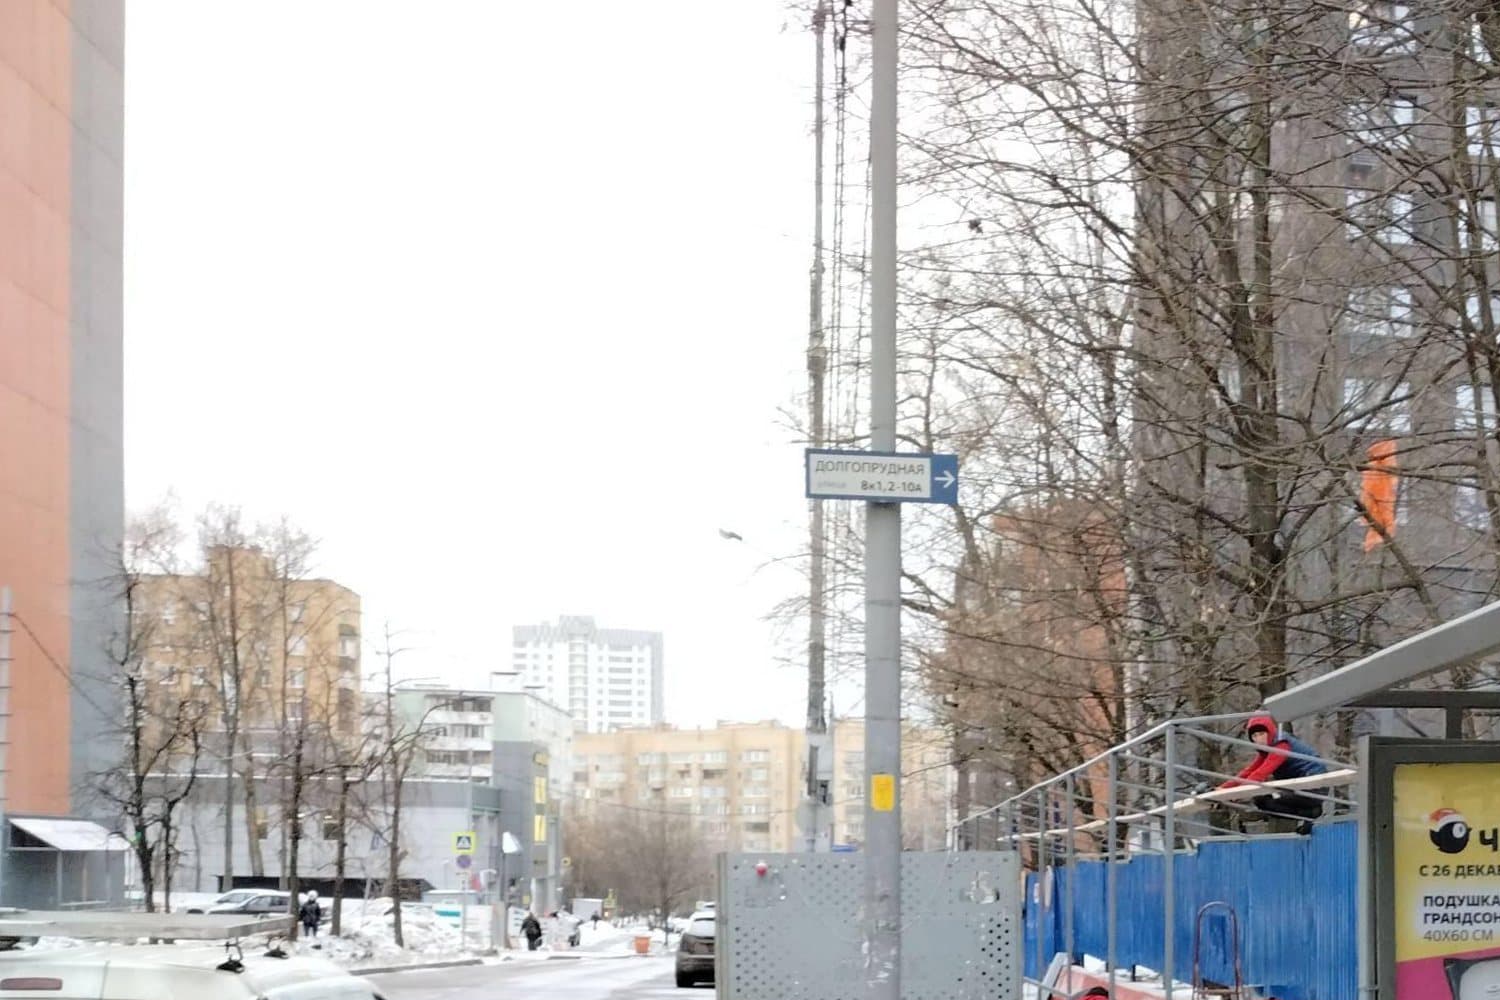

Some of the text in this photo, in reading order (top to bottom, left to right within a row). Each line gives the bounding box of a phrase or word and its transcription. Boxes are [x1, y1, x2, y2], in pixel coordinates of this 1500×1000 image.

[815, 460, 925, 475] ДОЛГОПРУДНАЯ
[1419, 865, 1429, 877] С
[1432, 865, 1451, 877] 26
[1423, 895, 1500, 909] ПОДУШКА
[1472, 930, 1494, 941] СМ
